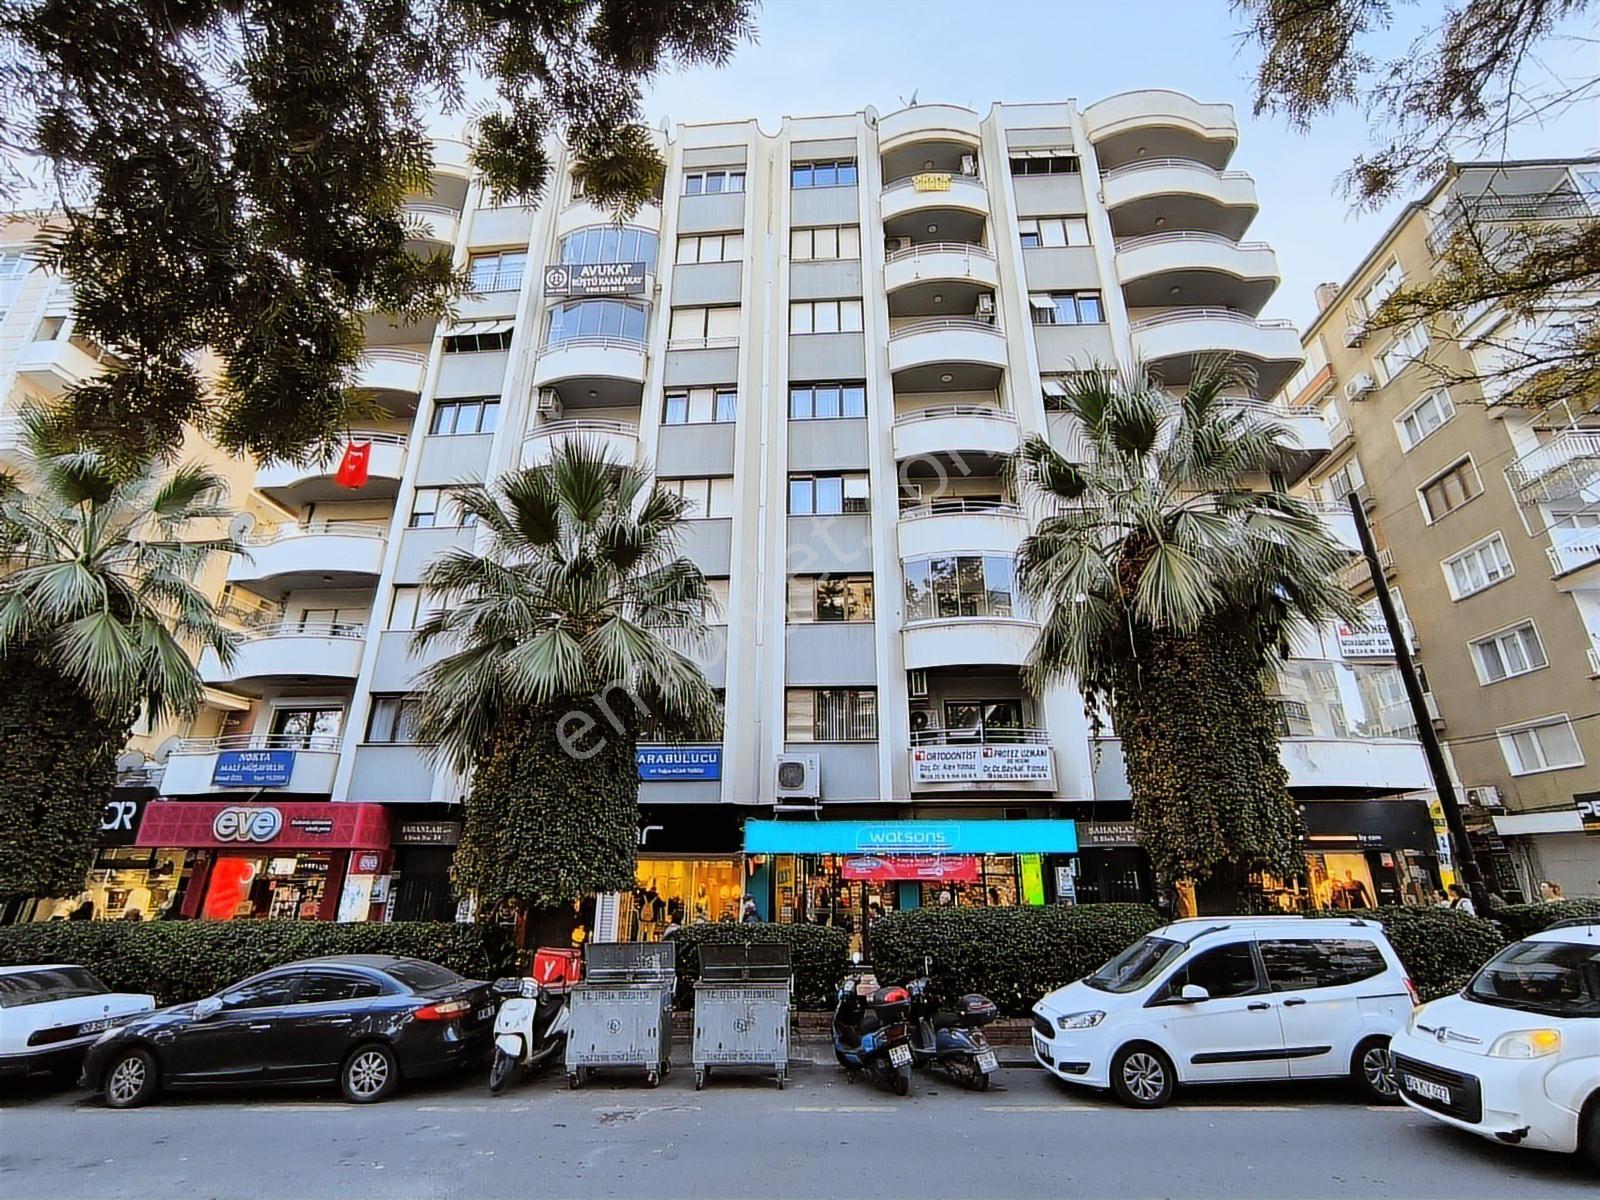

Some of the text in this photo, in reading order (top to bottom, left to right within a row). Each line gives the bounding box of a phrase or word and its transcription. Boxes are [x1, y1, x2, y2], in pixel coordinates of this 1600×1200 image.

[580, 264, 632, 276] AVUKAT
[637, 753, 717, 763] ARABULUCU
[215, 809, 279, 840] eve
[869, 831, 945, 843] watsons
